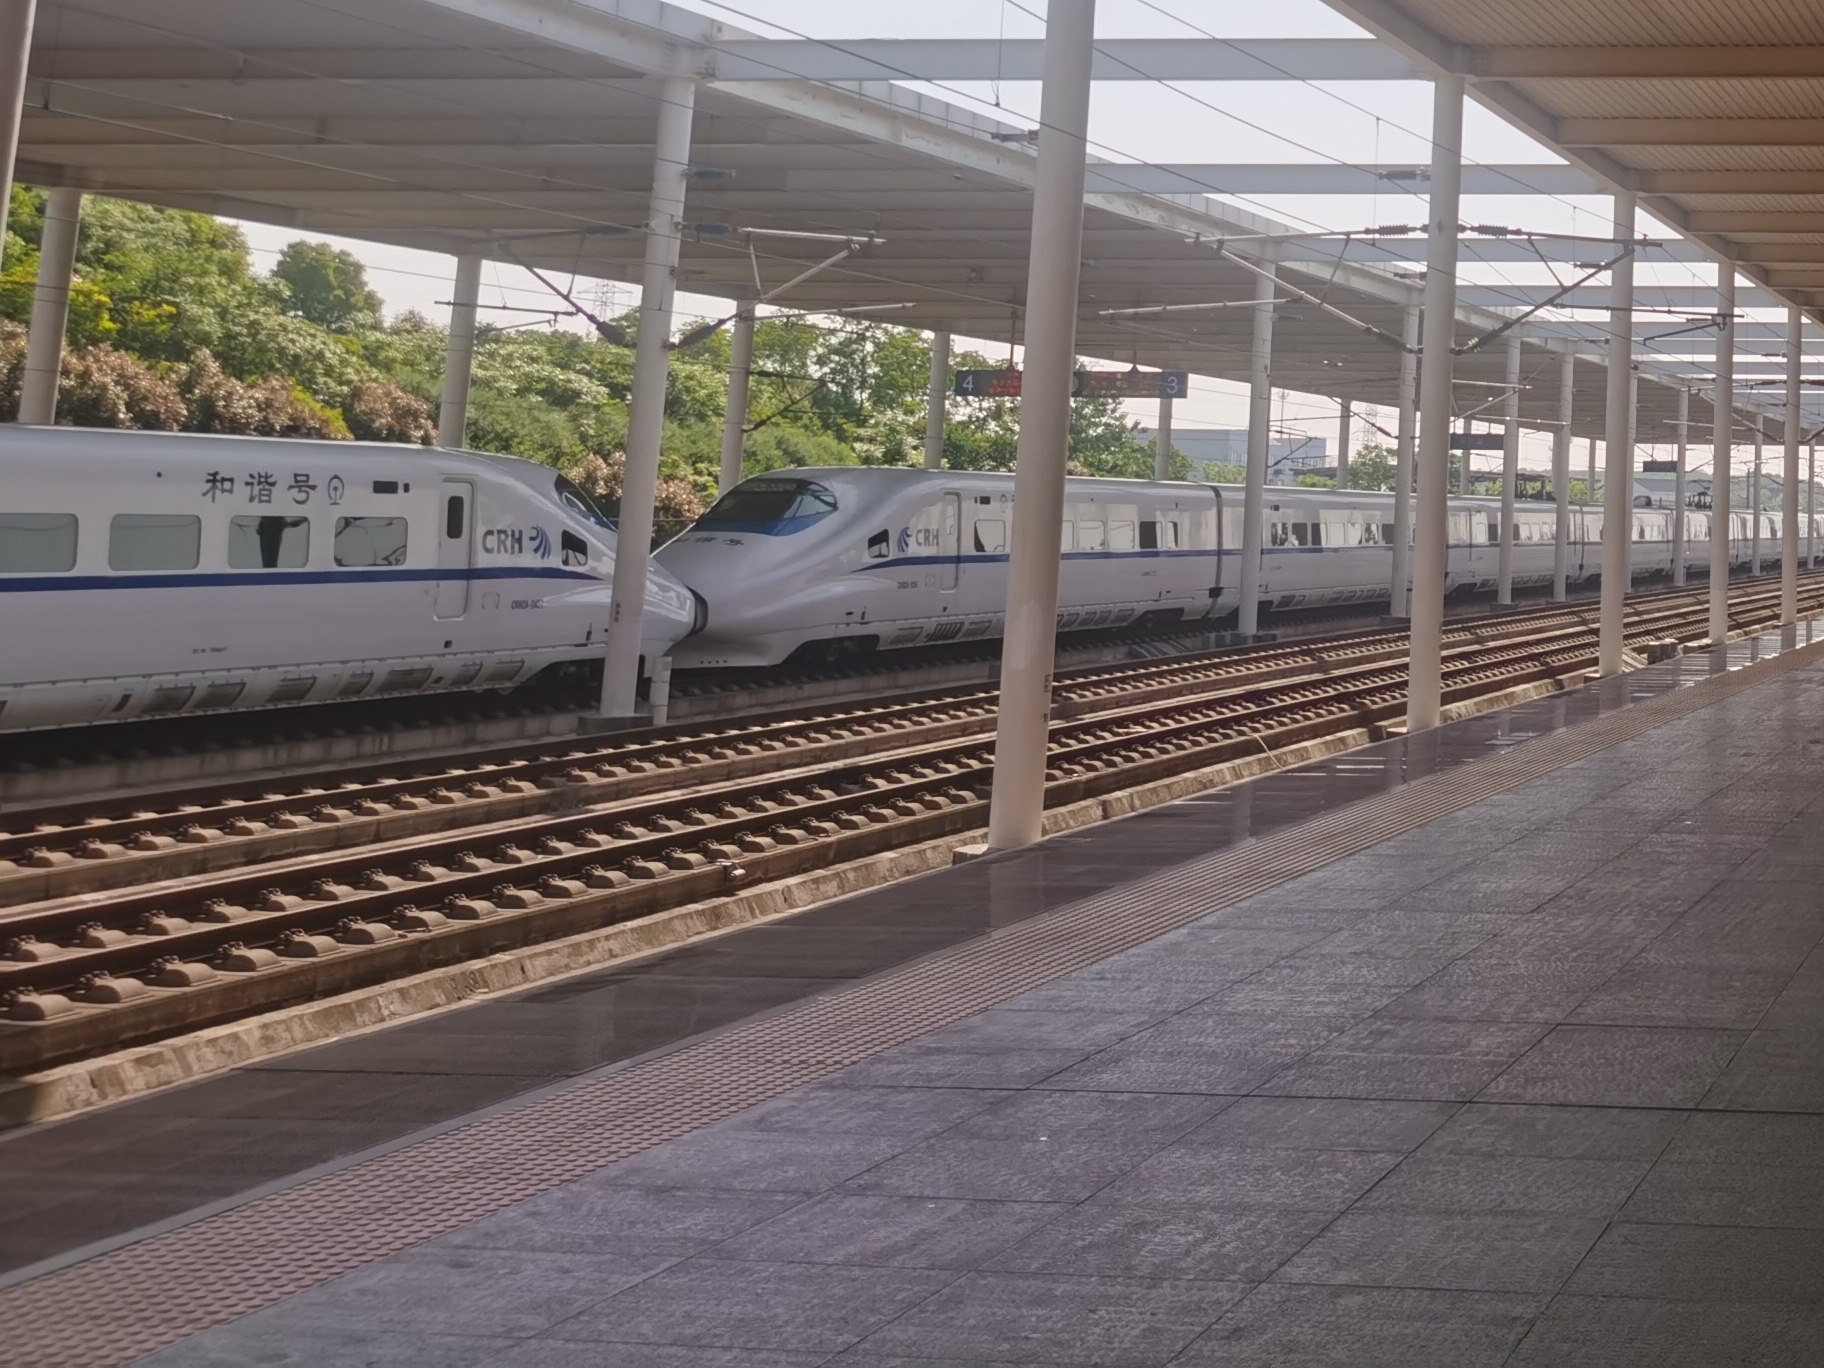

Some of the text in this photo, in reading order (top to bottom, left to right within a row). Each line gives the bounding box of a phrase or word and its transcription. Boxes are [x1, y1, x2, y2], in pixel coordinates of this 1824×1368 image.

[961, 374, 974, 392] 4
[1166, 376, 1179, 394] 3
[201, 470, 319, 505] 和谐号
[482, 529, 523, 554] CRH
[915, 528, 940, 547] CRH
